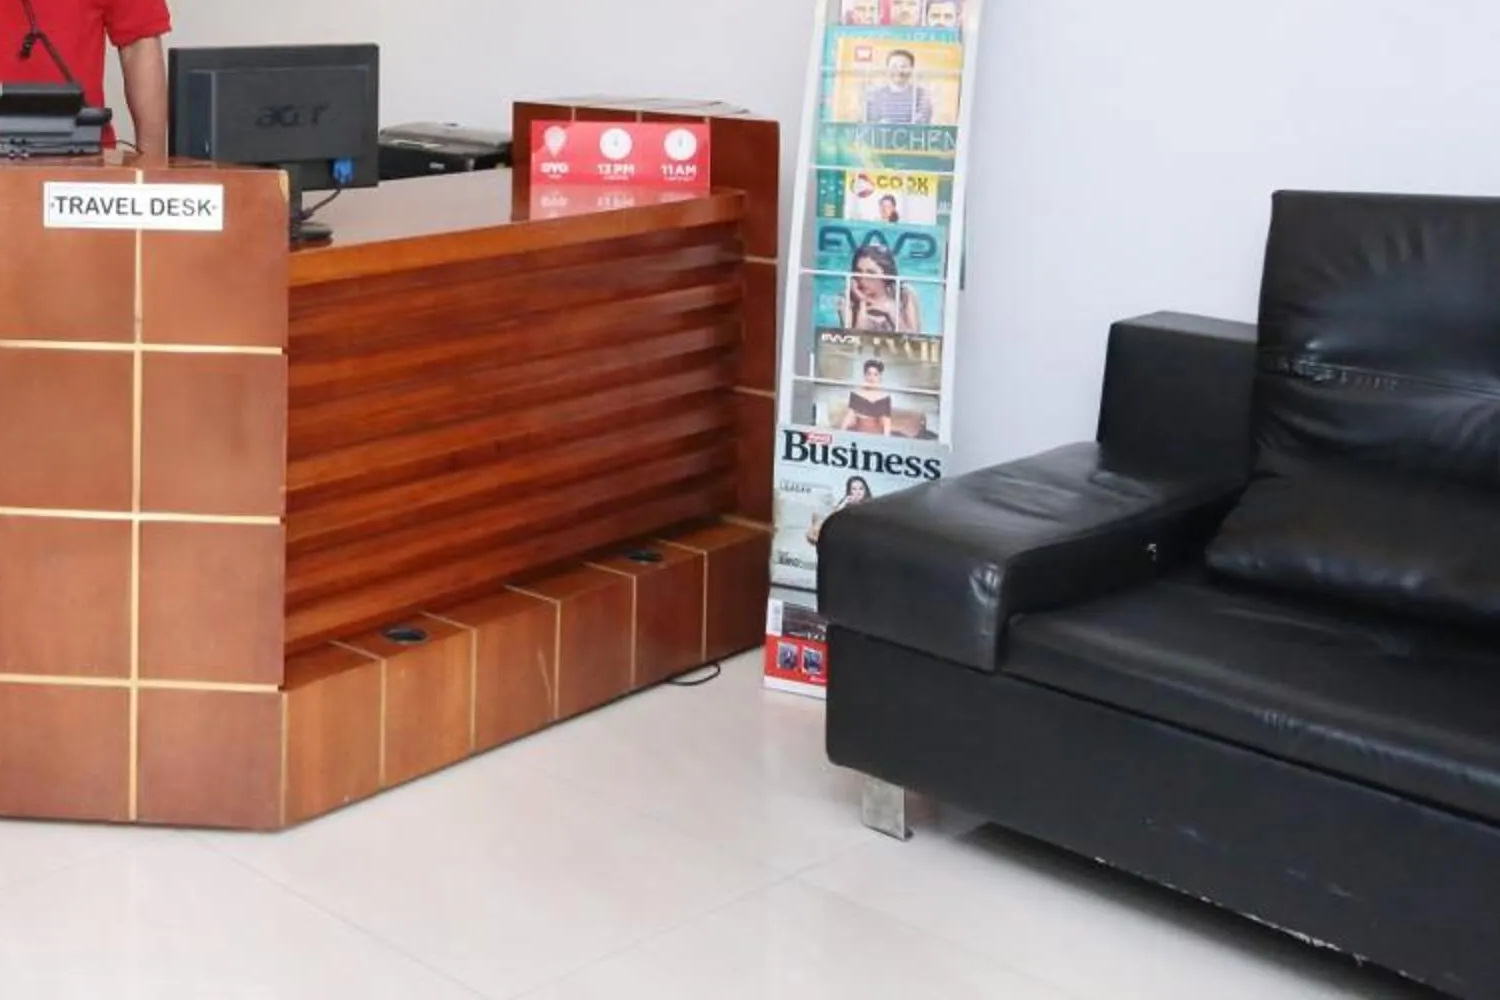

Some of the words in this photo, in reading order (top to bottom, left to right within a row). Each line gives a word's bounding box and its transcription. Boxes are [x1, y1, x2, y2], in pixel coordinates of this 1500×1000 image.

[254, 101, 330, 129] acer
[54, 195, 143, 216] TRAVEL
[150, 198, 212, 217] DESK
[781, 429, 942, 482] Business
